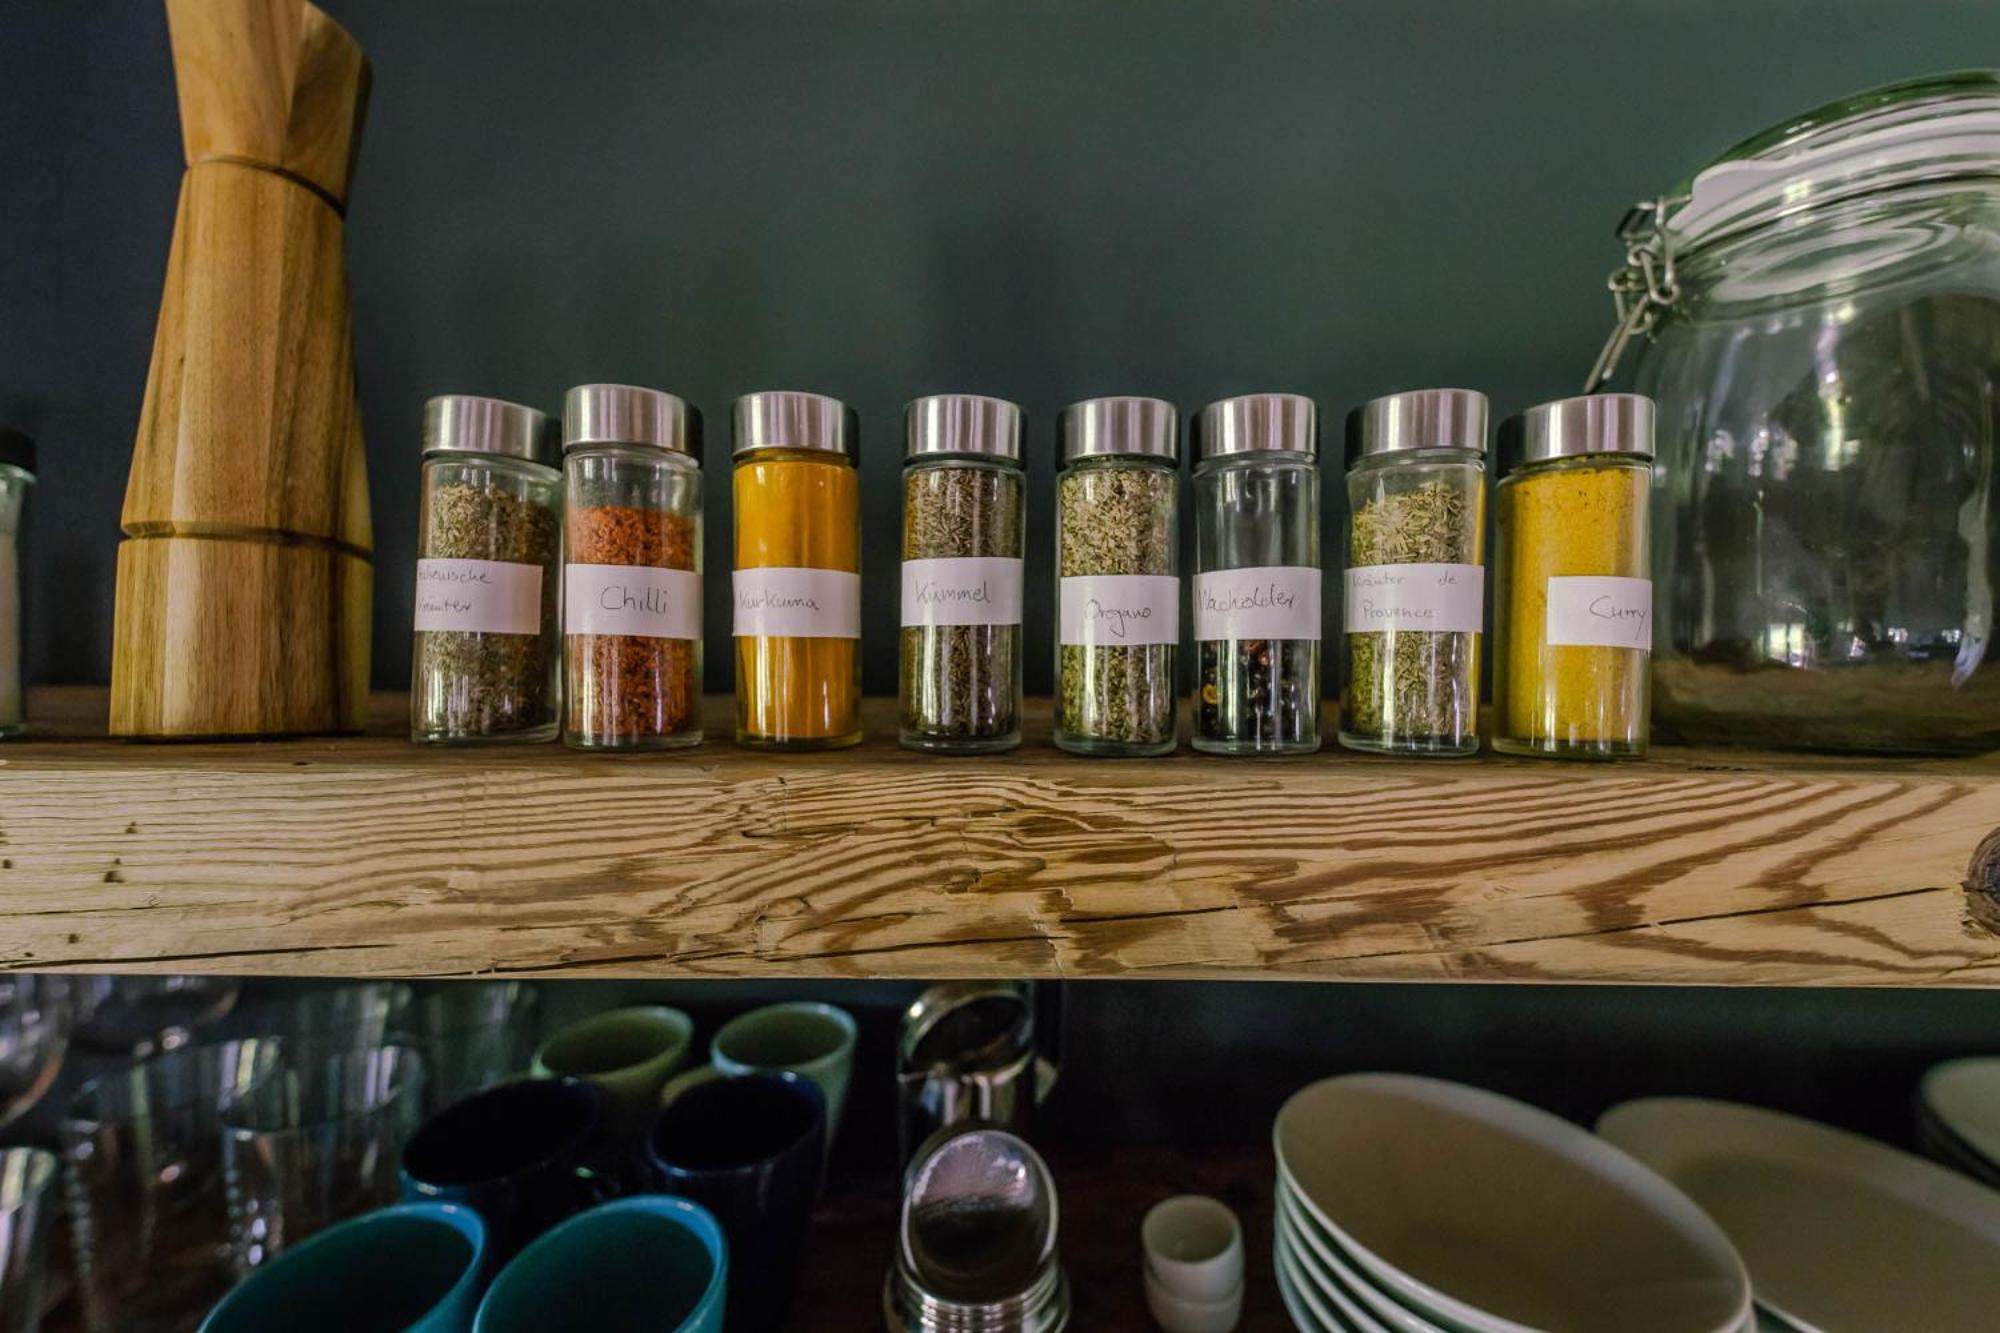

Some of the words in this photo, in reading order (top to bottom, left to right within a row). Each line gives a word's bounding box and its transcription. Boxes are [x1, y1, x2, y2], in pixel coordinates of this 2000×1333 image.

[600, 585, 668, 614] Chilli
[914, 580, 992, 604] Kümmel
[1588, 595, 1648, 641] Curry
